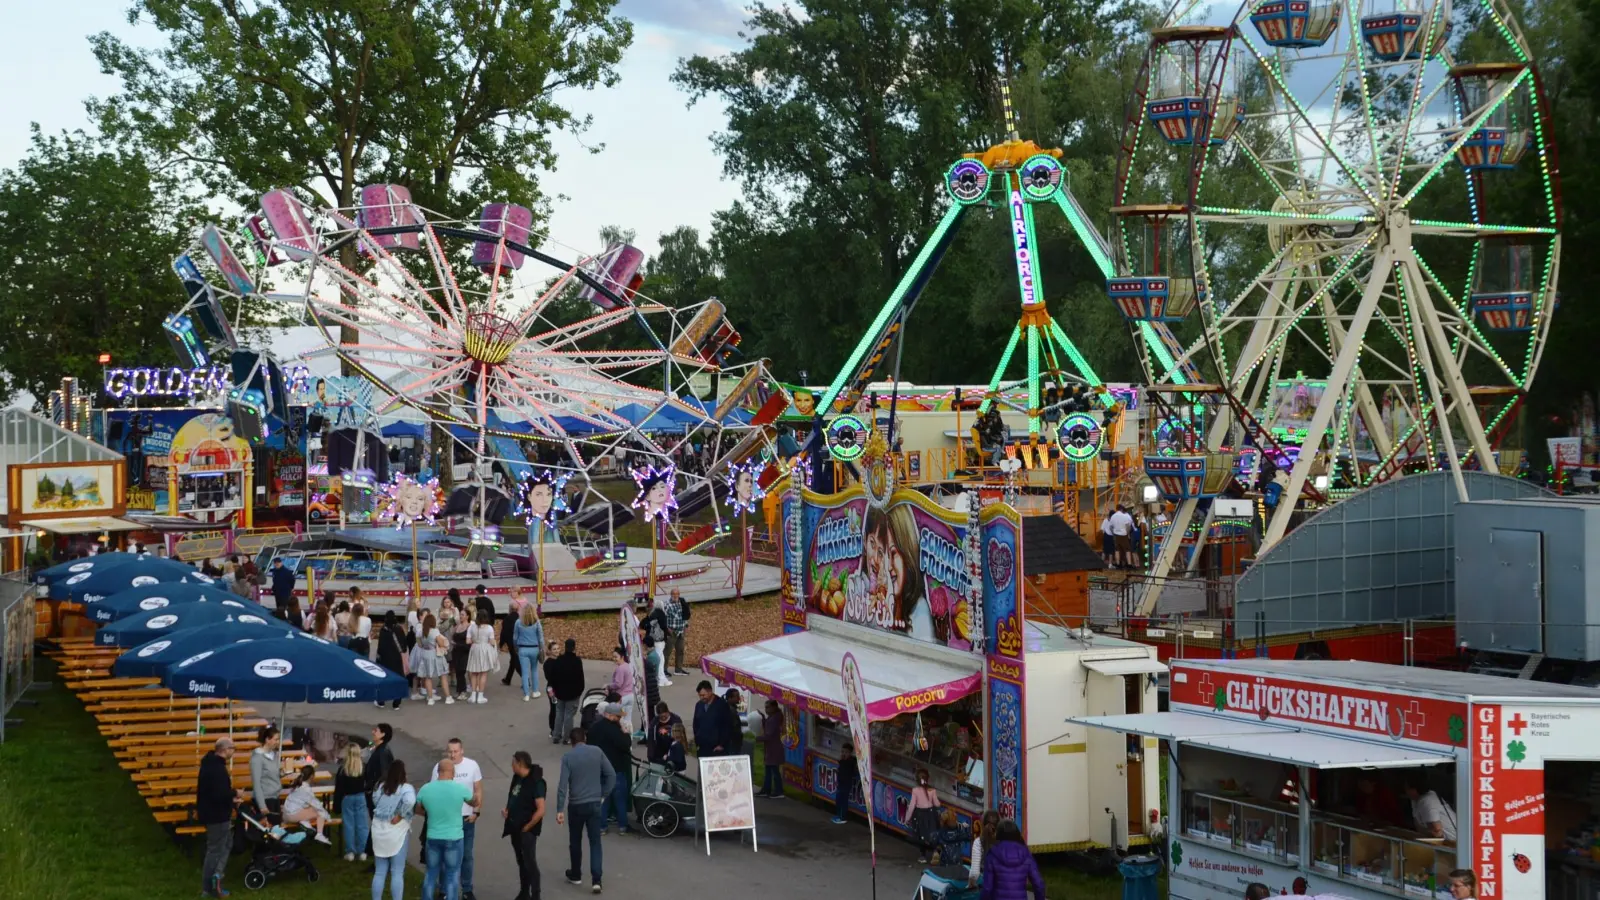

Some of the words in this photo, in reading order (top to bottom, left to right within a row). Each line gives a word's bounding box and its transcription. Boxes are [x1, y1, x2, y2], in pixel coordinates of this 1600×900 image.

[106, 366, 228, 398] GOLDEN
[817, 516, 849, 545] NÜSSE
[816, 533, 864, 566] MANDELN
[188, 680, 216, 694] Spalter
[323, 687, 356, 701] Spalter
[1226, 677, 1389, 732] GLÜCKSHAFEN
[1530, 713, 1571, 721] Bayerisches
[1479, 707, 1496, 897] GLÜCKSHAFEN
[1504, 799, 1525, 811] Helfen
[1525, 795, 1536, 804] Sie
[1505, 810, 1530, 822] anderen
[1189, 857, 1204, 870] Helfen
[1204, 859, 1212, 869] Sie
[1221, 860, 1240, 872] anderen
[1240, 866, 1247, 875] zu
[1247, 864, 1263, 876] helfen
